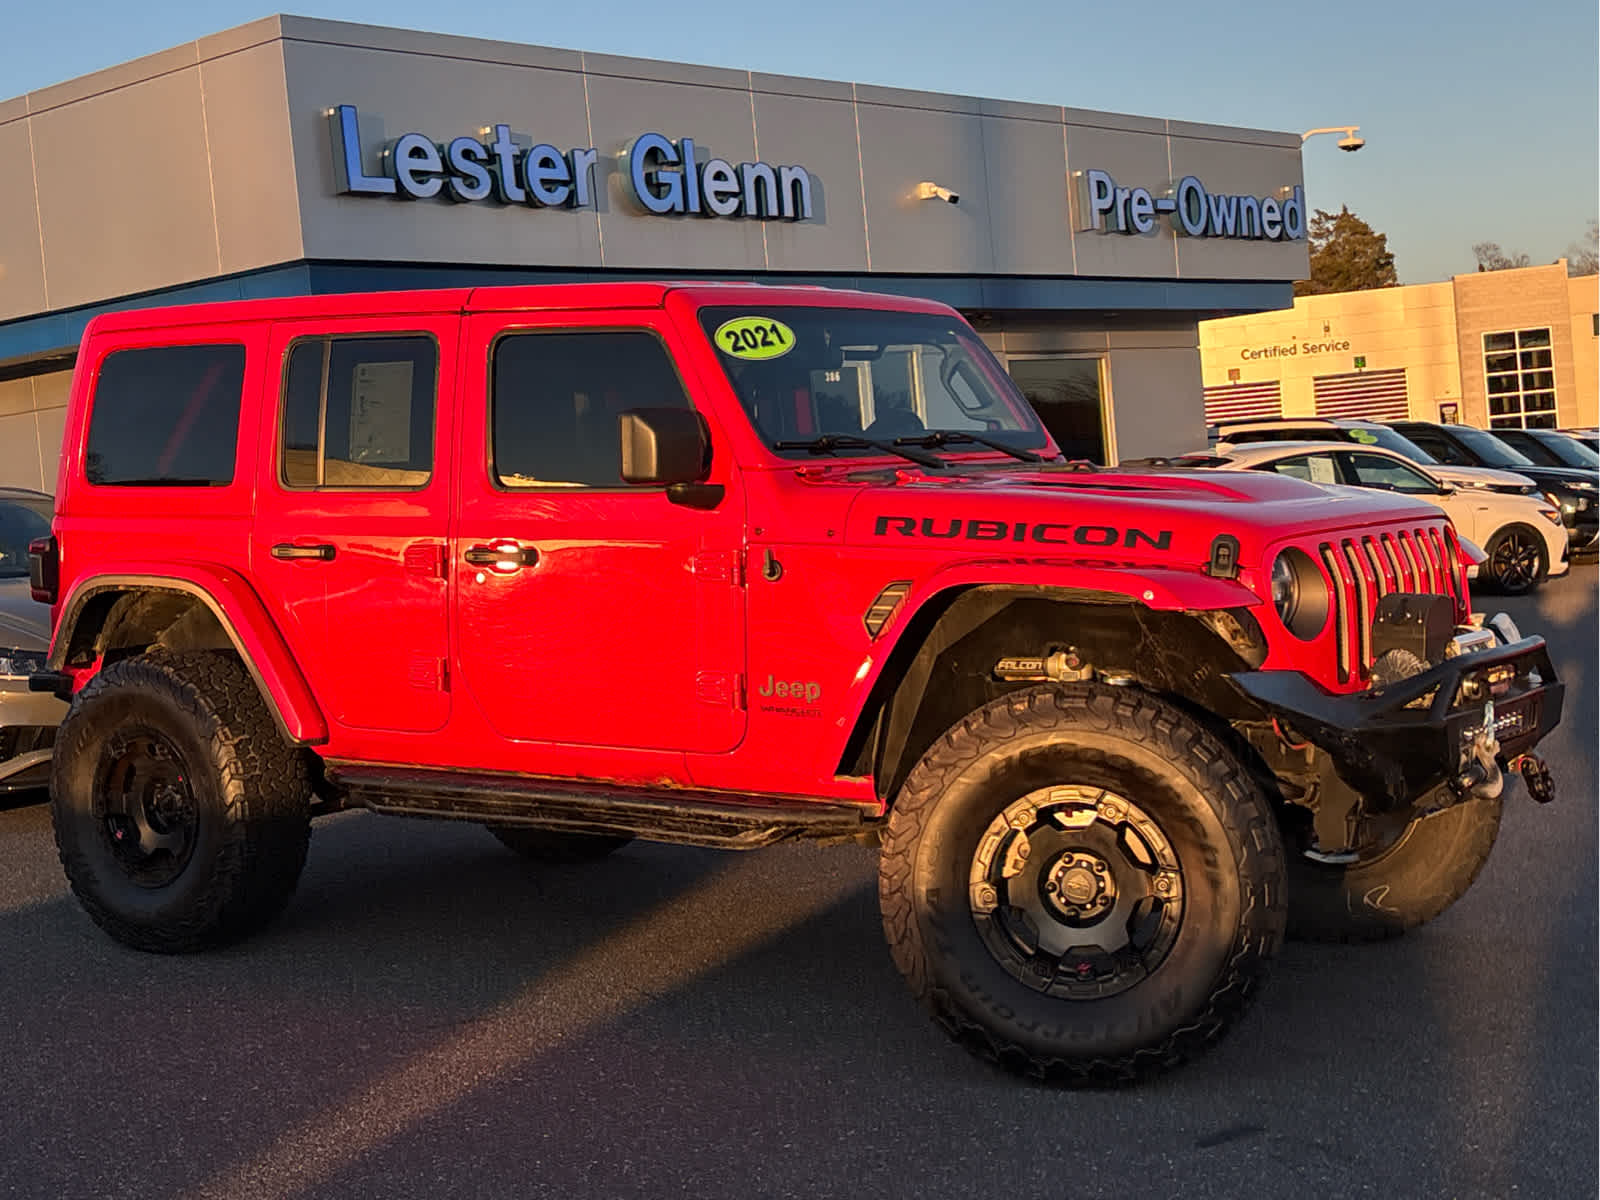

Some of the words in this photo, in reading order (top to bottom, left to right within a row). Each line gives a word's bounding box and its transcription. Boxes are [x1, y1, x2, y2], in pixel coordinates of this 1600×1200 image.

[337, 104, 598, 208] Lester
[630, 132, 813, 219] Glenn
[1087, 169, 1306, 241] Pre-Owned
[724, 323, 786, 353] 2021
[1240, 343, 1297, 361] Certified
[1301, 340, 1350, 355] Service
[873, 515, 1173, 551] RUBICON
[758, 673, 821, 704] Jeep
